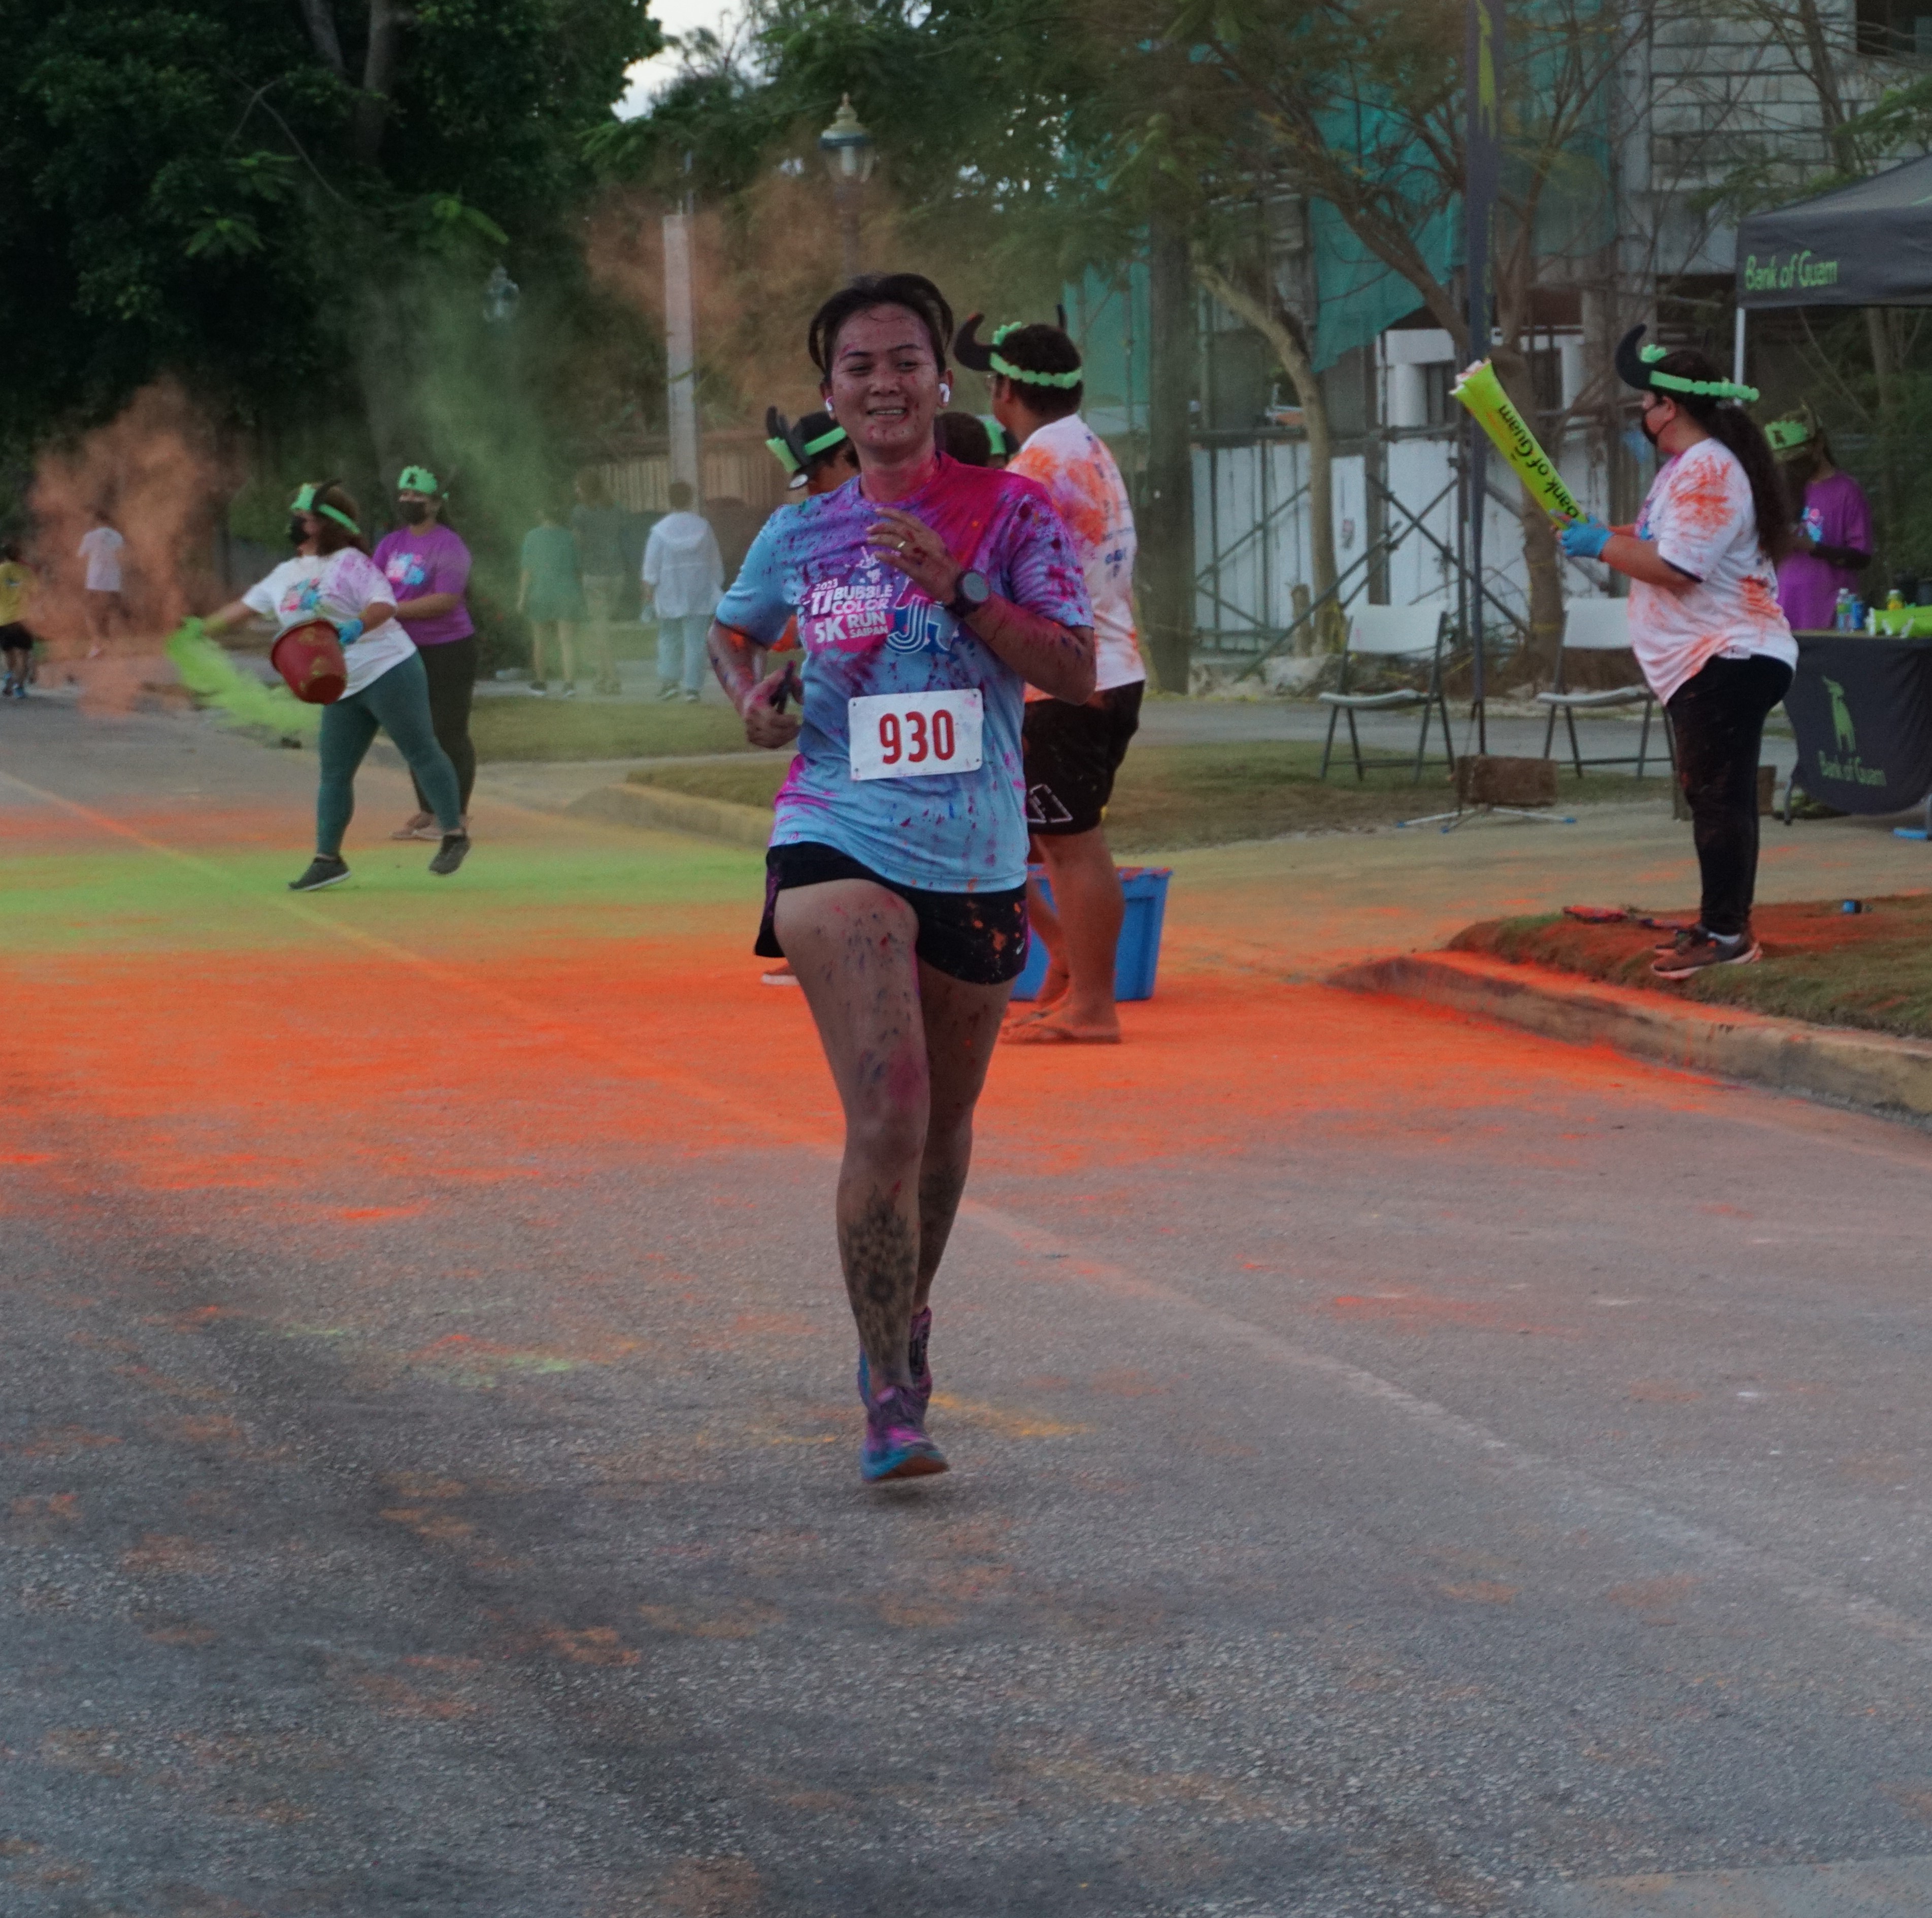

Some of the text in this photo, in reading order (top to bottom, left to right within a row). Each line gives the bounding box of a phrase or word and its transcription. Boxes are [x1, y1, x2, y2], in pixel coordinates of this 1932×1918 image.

[1498, 405, 1534, 457] Guam
[1526, 458, 1548, 476] of
[814, 578, 838, 591] 2023
[833, 584, 893, 601] BUBBLE
[831, 598, 889, 615] COLOR
[847, 611, 886, 629] RUN
[815, 615, 848, 644] 5K
[849, 626, 889, 638] SAIPAN
[879, 709, 955, 764] 930
